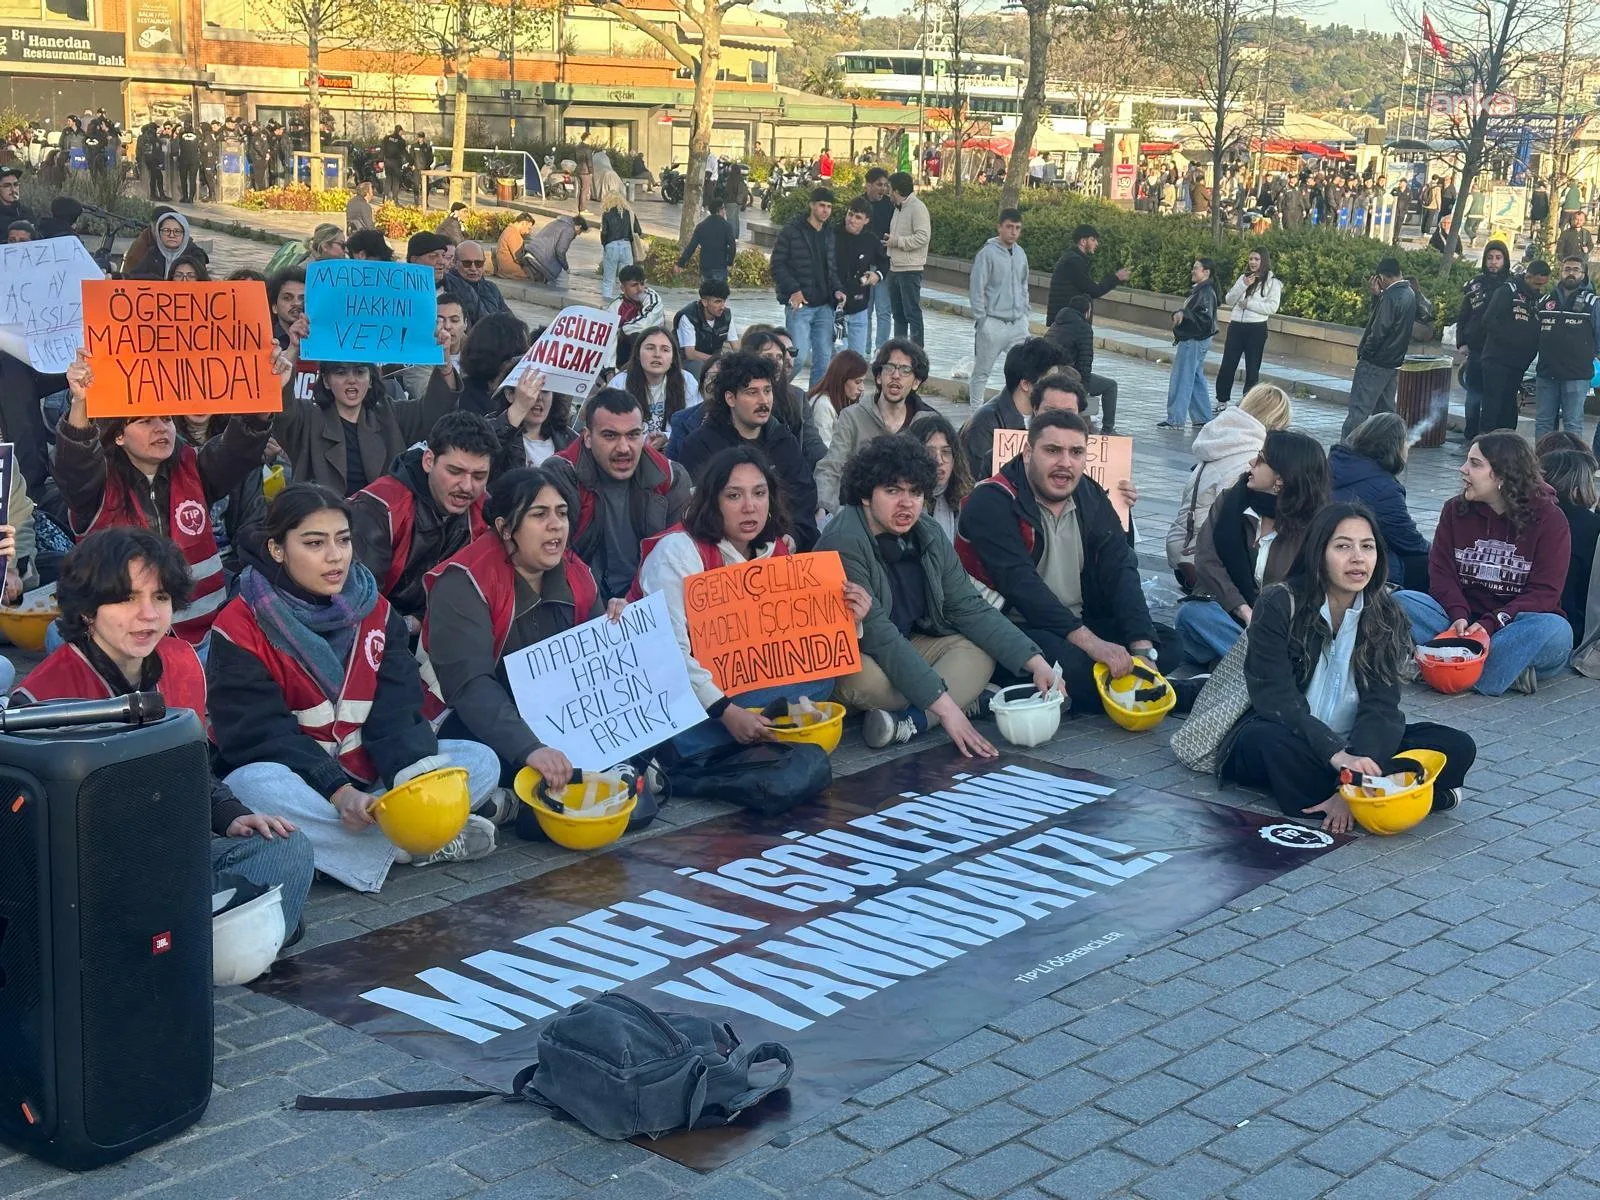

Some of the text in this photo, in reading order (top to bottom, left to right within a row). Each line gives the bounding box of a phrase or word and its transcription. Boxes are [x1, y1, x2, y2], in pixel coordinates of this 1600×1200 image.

[12, 29, 25, 41] Et
[29, 35, 91, 49] Hanedan
[23, 48, 96, 61] Restaurantları
[98, 55, 125, 66] Balık
[4, 240, 84, 272] FAZLA
[312, 266, 429, 292] MADENCİNİN
[109, 286, 236, 322] ÖĞRENCİ
[346, 295, 413, 317] HAKKINI
[88, 320, 261, 355] MADENCİNİN
[335, 321, 408, 352] VER!
[116, 355, 260, 404] YANINDA!
[688, 556, 821, 612] GENÇLİK
[692, 609, 749, 652] MADEN
[571, 641, 639, 692] HAKKI
[713, 630, 855, 691] YANINDA
[545, 668, 653, 735] VERİLSİN
[590, 690, 678, 755] ARTIK!
[358, 765, 1117, 1044] MADEN İŞÇİLERİNİN
[156, 937, 169, 949] JBL
[652, 827, 1174, 1031] YANINDAYIZ!
[1047, 931, 1125, 967] ÖĞRENCİLER
